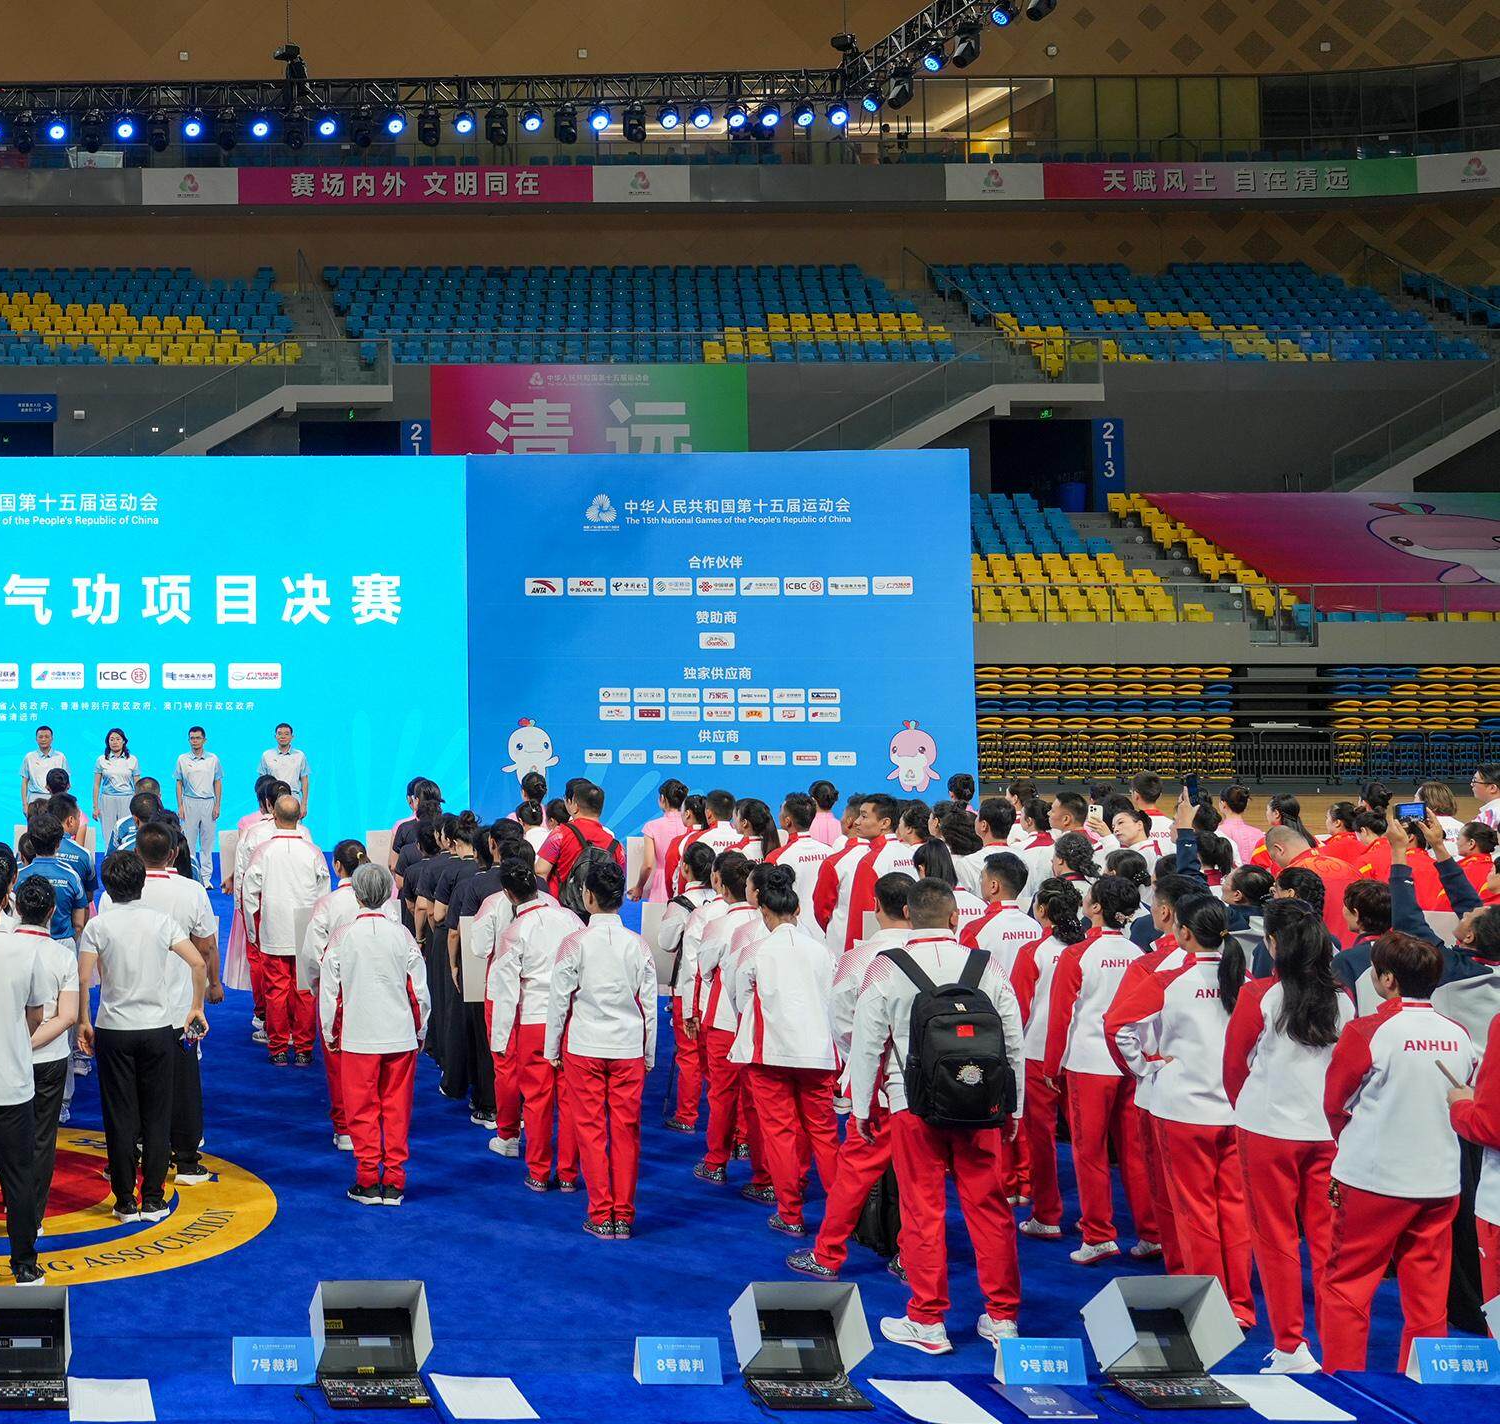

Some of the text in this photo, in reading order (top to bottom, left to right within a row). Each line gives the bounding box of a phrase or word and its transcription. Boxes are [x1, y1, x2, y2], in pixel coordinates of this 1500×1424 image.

[290, 170, 541, 198] 赛场内外 文明同在
[1102, 166, 1352, 193] 天赋风土 自在清远
[1102, 422, 1116, 478] 213
[624, 498, 851, 515] 中华人民共和国第十五届运动会
[2, 516, 13, 525] of
[14, 516, 30, 525] the
[33, 516, 72, 526] People's
[75, 516, 116, 526] Republic
[119, 516, 129, 525] of
[131, 516, 159, 525] China
[625, 516, 852, 525] The 15th National Games of the People's Republic of China
[688, 556, 743, 570] 合作伙伴
[531, 586, 547, 594] ANTA
[785, 582, 806, 590] ICBC
[695, 610, 737, 625] 赞助商
[99, 671, 127, 681] ICBC
[683, 666, 751, 681] 独家供应商
[698, 729, 740, 744] 供应商
[957, 907, 982, 916] HUI
[1002, 930, 1038, 941] ANHUI
[1403, 1039, 1459, 1052] ANHUI
[83, 1208, 236, 1269] ASSOCIATION
[251, 1358, 299, 1372] 7号裁判
[656, 1358, 705, 1372] 8号裁判
[1020, 1359, 1068, 1373] 9号裁判
[1431, 1358, 1489, 1373] 10号裁判
